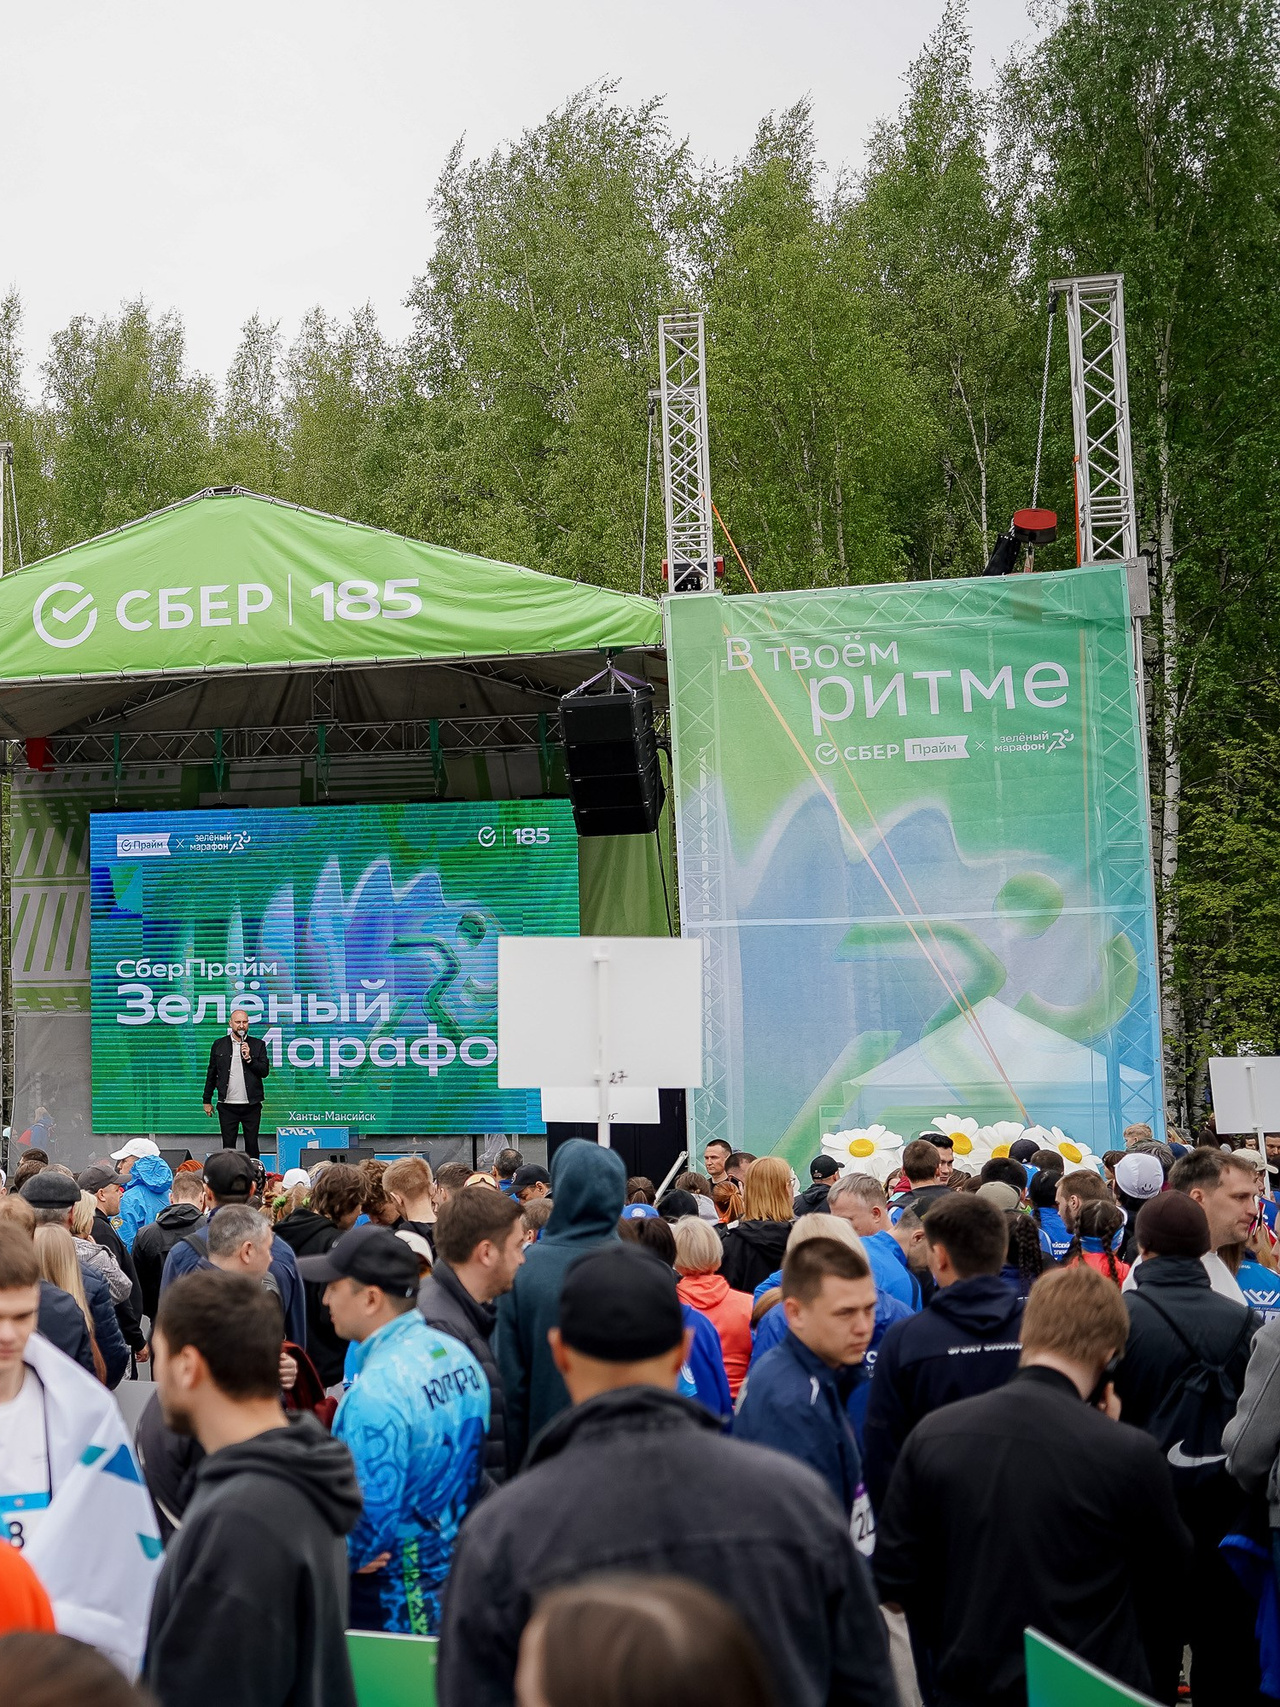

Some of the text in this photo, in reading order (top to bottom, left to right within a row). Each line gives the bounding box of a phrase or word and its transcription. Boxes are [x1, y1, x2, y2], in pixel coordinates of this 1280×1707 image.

[116, 578, 423, 632] СБЕР 185
[726, 634, 899, 671] В твоём
[809, 661, 1070, 736] ритме
[999, 731, 1049, 743] зелёный
[843, 742, 957, 761] СБЕР Прайм
[994, 742, 1046, 754] марафон
[133, 839, 163, 851] Прайм
[194, 831, 232, 842] зелёный
[512, 827, 550, 845] 185
[189, 841, 229, 853] марафон
[116, 956, 278, 981] СберПрайм
[116, 979, 390, 1025] Зелёный
[227, 1024, 498, 1078] арафо
[288, 1111, 376, 1122] Ханты-Мансийск
